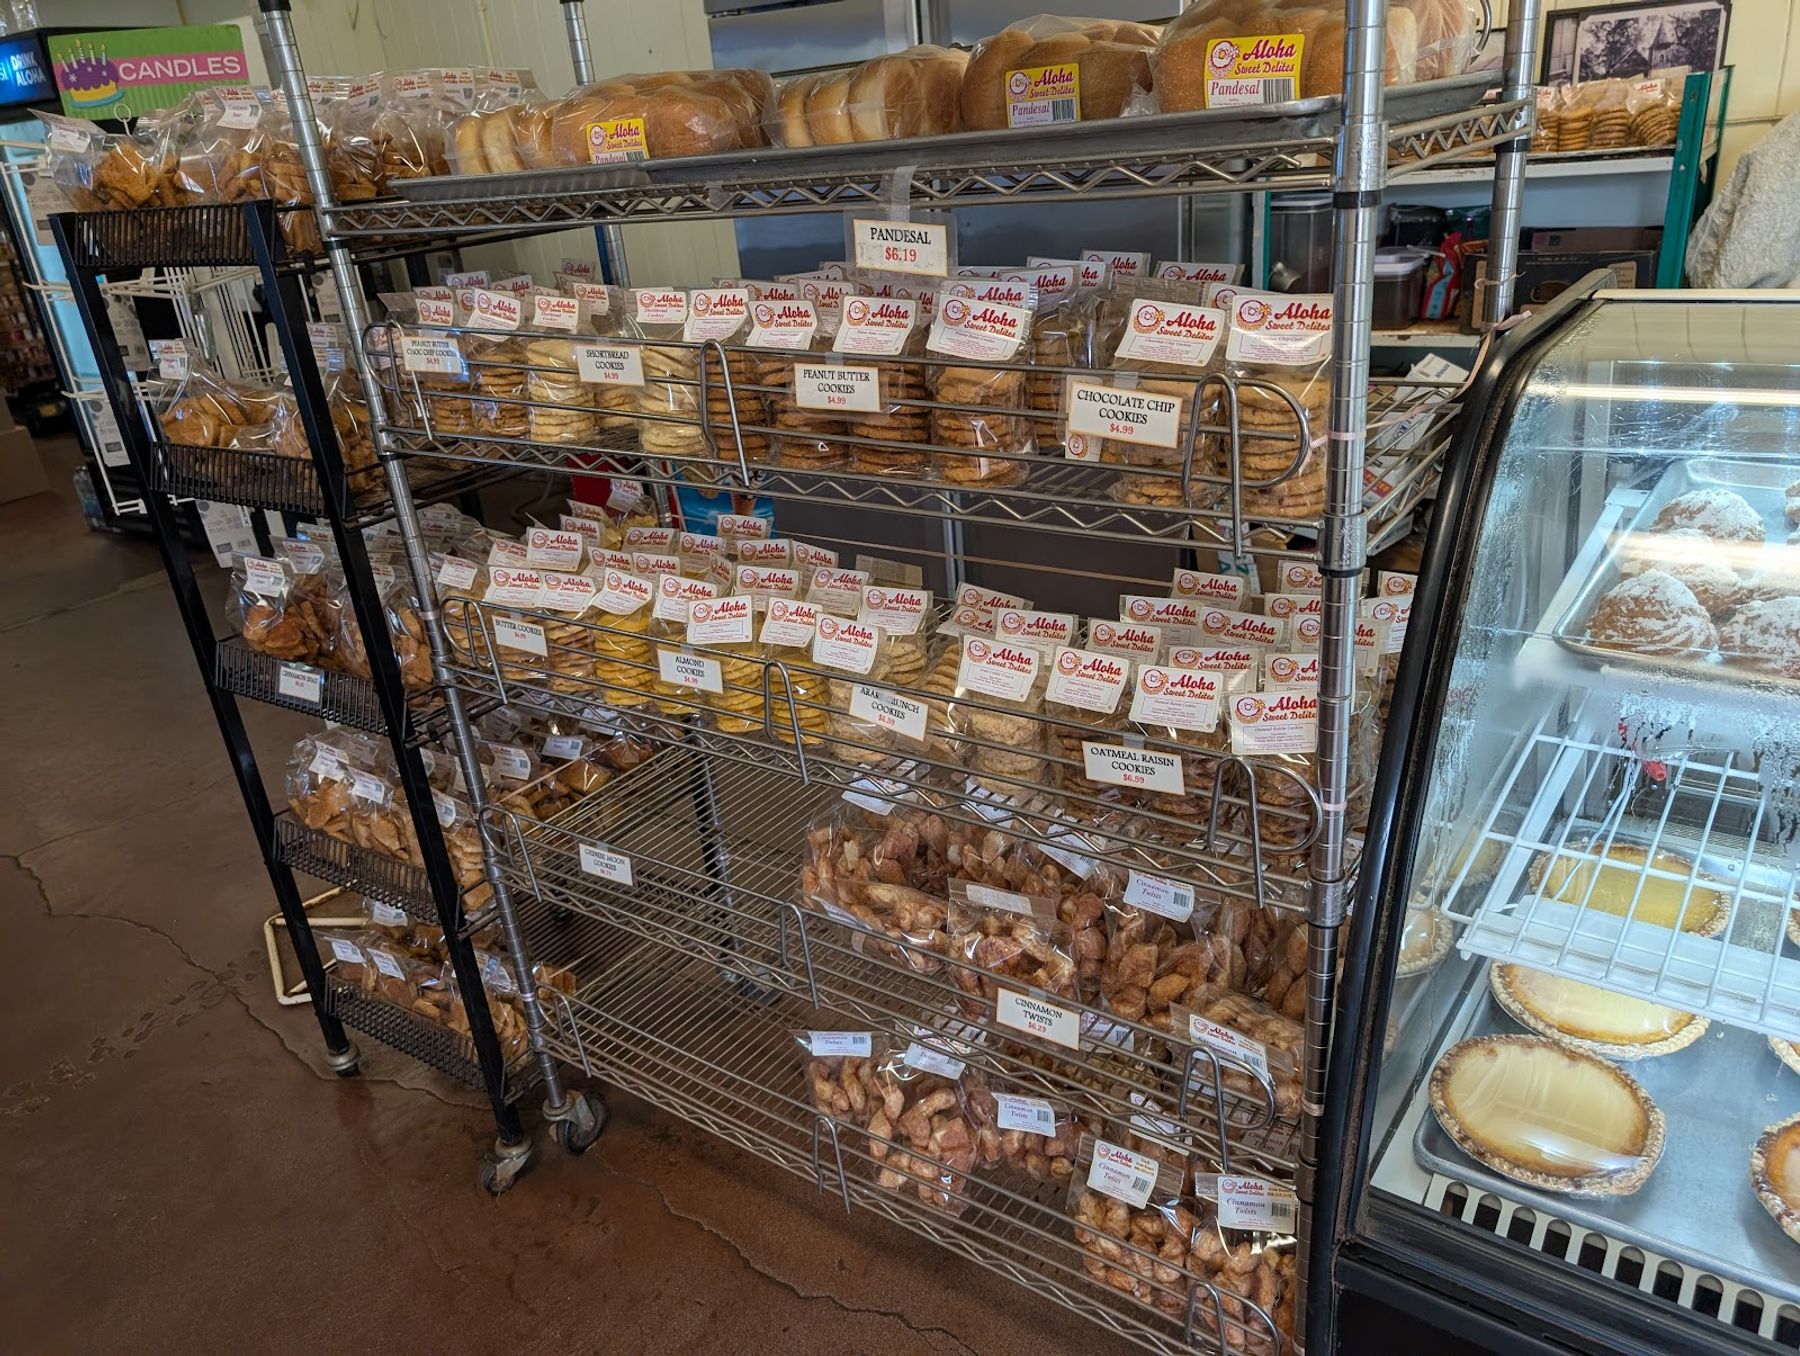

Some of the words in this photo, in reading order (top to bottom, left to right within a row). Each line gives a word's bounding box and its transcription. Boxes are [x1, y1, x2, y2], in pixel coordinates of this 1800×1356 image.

[1242, 37, 1296, 61] Aloha
[11, 51, 36, 70] DRINK
[118, 55, 241, 81] CANDLES
[1235, 62, 1262, 75] Sweet
[1263, 61, 1295, 73] Delites
[16, 67, 46, 87] ALOHA
[1034, 70, 1075, 87] Aloha
[1029, 87, 1049, 99] Sweet
[1049, 85, 1075, 98] Delites
[1210, 80, 1260, 96] Pandesal
[1011, 101, 1051, 117] Pandesal
[609, 122, 641, 140] Aloha
[595, 151, 626, 163] Pandesal
[870, 227, 931, 245] PANDESAL
[885, 246, 917, 263] $6.19
[1186, 268, 1227, 282] Aloha
[657, 294, 684, 304] Aloha
[714, 293, 744, 308] Aloha
[764, 288, 796, 300] Aloha
[978, 286, 1023, 302] Aloha
[493, 299, 517, 314] Aloha
[552, 299, 575, 310] Aloha
[871, 303, 910, 319] Aloha
[778, 306, 811, 319] Aloha
[973, 308, 1018, 328] Aloha
[1274, 303, 1333, 321] Aloha
[1166, 311, 1217, 331] Aloha
[1265, 320, 1294, 331] Sweet
[1296, 320, 1331, 332] Delites
[964, 321, 988, 333] Sweet
[988, 325, 1016, 338] Delites
[1156, 326, 1182, 338] Sweet
[1183, 329, 1214, 341] Delites
[586, 349, 630, 359] SHORTBREAD
[595, 360, 625, 371] COOKIES
[604, 371, 619, 380] $4.99
[803, 369, 836, 382] PEANUT
[837, 370, 871, 383] BUTTER
[817, 382, 856, 394] COOKIES
[827, 395, 846, 405] $4.99
[1077, 389, 1145, 410] CHOCOLATE
[1147, 400, 1175, 413] CHIP
[1099, 407, 1148, 425] COOKIES
[1109, 423, 1134, 436] $4.99
[737, 519, 762, 532] Aloha
[549, 533, 578, 546] Aloha
[644, 528, 669, 541] Aloha
[695, 538, 719, 551] Aloha
[758, 543, 785, 554] Aloha
[605, 554, 630, 566] Aloha
[648, 558, 676, 570] Aloha
[810, 551, 832, 564] Aloha
[512, 571, 541, 584] Aloha
[564, 576, 591, 588] Aloha
[761, 572, 793, 585] Aloha
[833, 573, 862, 586] Aloha
[623, 579, 649, 595] Aloha
[682, 583, 713, 597] Aloha
[1201, 577, 1237, 593] Aloha
[888, 593, 922, 607] Aloha
[984, 596, 1016, 609] Aloha
[714, 600, 748, 615] Aloha
[1156, 603, 1196, 618] Aloha
[495, 619, 517, 630] BUTTER
[517, 622, 543, 636] COOKIES
[1026, 616, 1067, 632] Aloha
[1231, 618, 1277, 636] Aloha
[840, 625, 874, 640] Aloha
[1020, 627, 1042, 638] Sweet
[1117, 628, 1155, 644] Aloha
[1224, 628, 1247, 640] Sweet
[1248, 632, 1275, 645] Delites
[1110, 639, 1130, 649] Sweet
[1130, 642, 1154, 653] Delites
[675, 656, 705, 668] ALMOND
[993, 648, 1033, 665] Aloha
[1204, 650, 1251, 662] Aloha
[676, 665, 705, 677] COOKIES
[986, 657, 1006, 669] Sweet
[1007, 661, 1032, 675] Delites
[1083, 658, 1123, 676] Aloha
[1075, 669, 1096, 680] Sweet
[1096, 673, 1121, 686] Delites
[1170, 674, 1216, 691] Aloha
[1163, 687, 1186, 697] Sweet
[1186, 689, 1215, 700] Delites
[871, 701, 906, 719] COOKIES
[1269, 695, 1317, 712] Aloha
[1263, 712, 1288, 722] Sweet
[1090, 746, 1140, 762] OATMEAL
[1141, 752, 1174, 767] RAISIN
[1111, 760, 1156, 776] COOKIES
[593, 860, 617, 871] COOKIES
[1136, 878, 1170, 894] Cinnamon
[1015, 997, 1063, 1019] CINNAMON
[1023, 1009, 1053, 1027] TWISTS
[1028, 1021, 1047, 1033] $6.29
[1210, 1027, 1235, 1040] Aloha
[1004, 1103, 1034, 1113] Cinnamon
[1111, 1150, 1133, 1163] Aloha
[1098, 1162, 1131, 1180] Cinnamon
[1103, 1171, 1122, 1184] Twists
[1238, 1181, 1264, 1191] Aloha
[1226, 1198, 1265, 1208] Cinnamon
[1235, 1207, 1257, 1216] Twists
